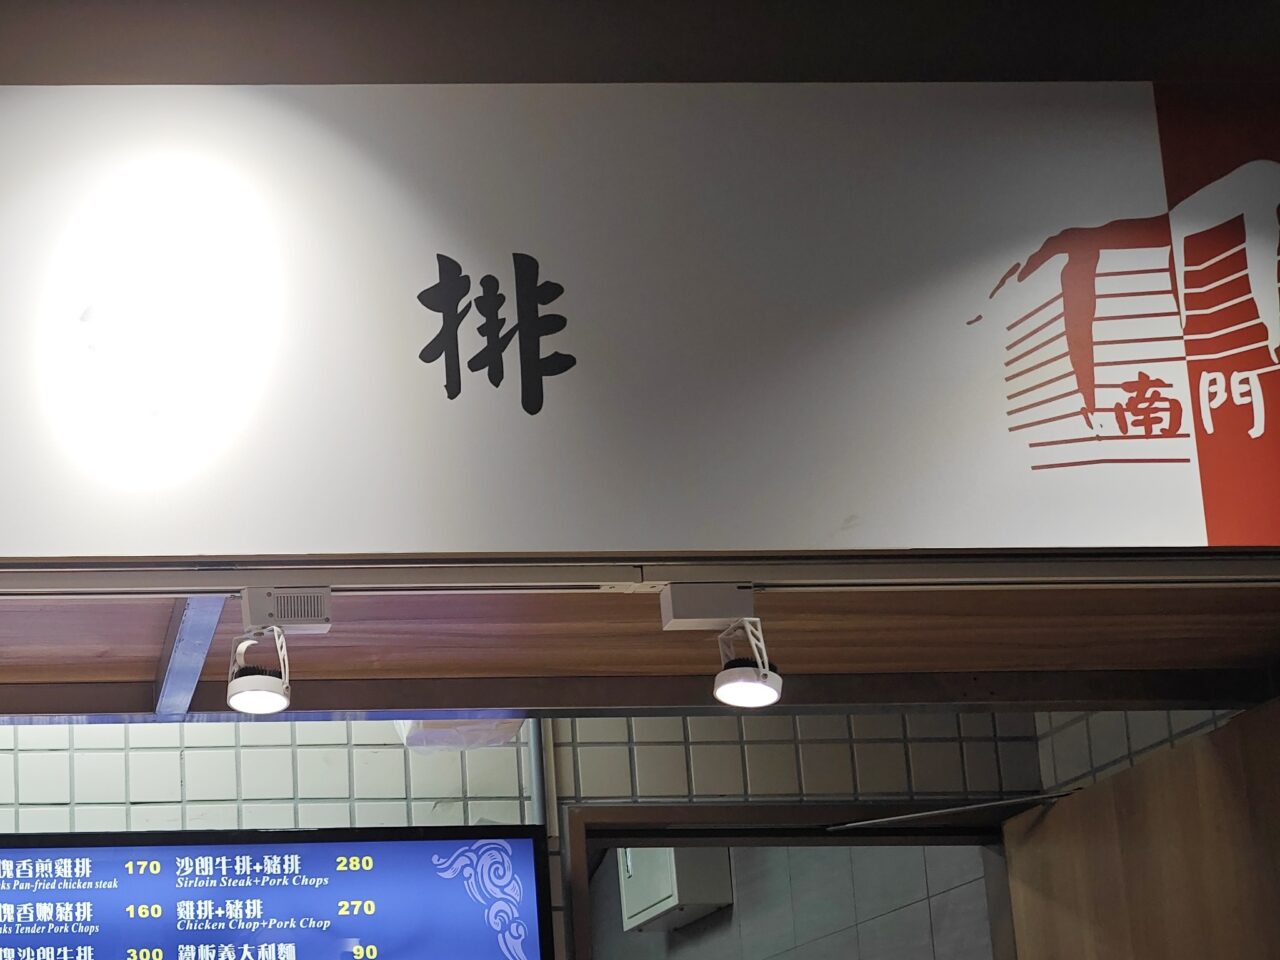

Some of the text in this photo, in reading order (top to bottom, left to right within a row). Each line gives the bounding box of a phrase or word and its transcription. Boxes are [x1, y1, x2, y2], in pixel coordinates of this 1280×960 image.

[124, 860, 161, 875] 170
[175, 854, 374, 876] 沙朗牛排+豬排 280
[12, 879, 56, 892] Pan-fried
[57, 878, 93, 890] chicken
[94, 878, 119, 889] steak
[175, 875, 329, 889] Sirloin Steak+Pork Chops
[125, 904, 162, 919] 160
[176, 898, 376, 921] 雞排+豬排 270
[14, 923, 46, 935] Tender
[47, 923, 69, 934] Pork
[71, 922, 100, 935] Chops
[176, 917, 331, 932] Chicken Chop+Pork Chop
[352, 944, 378, 960] 90
